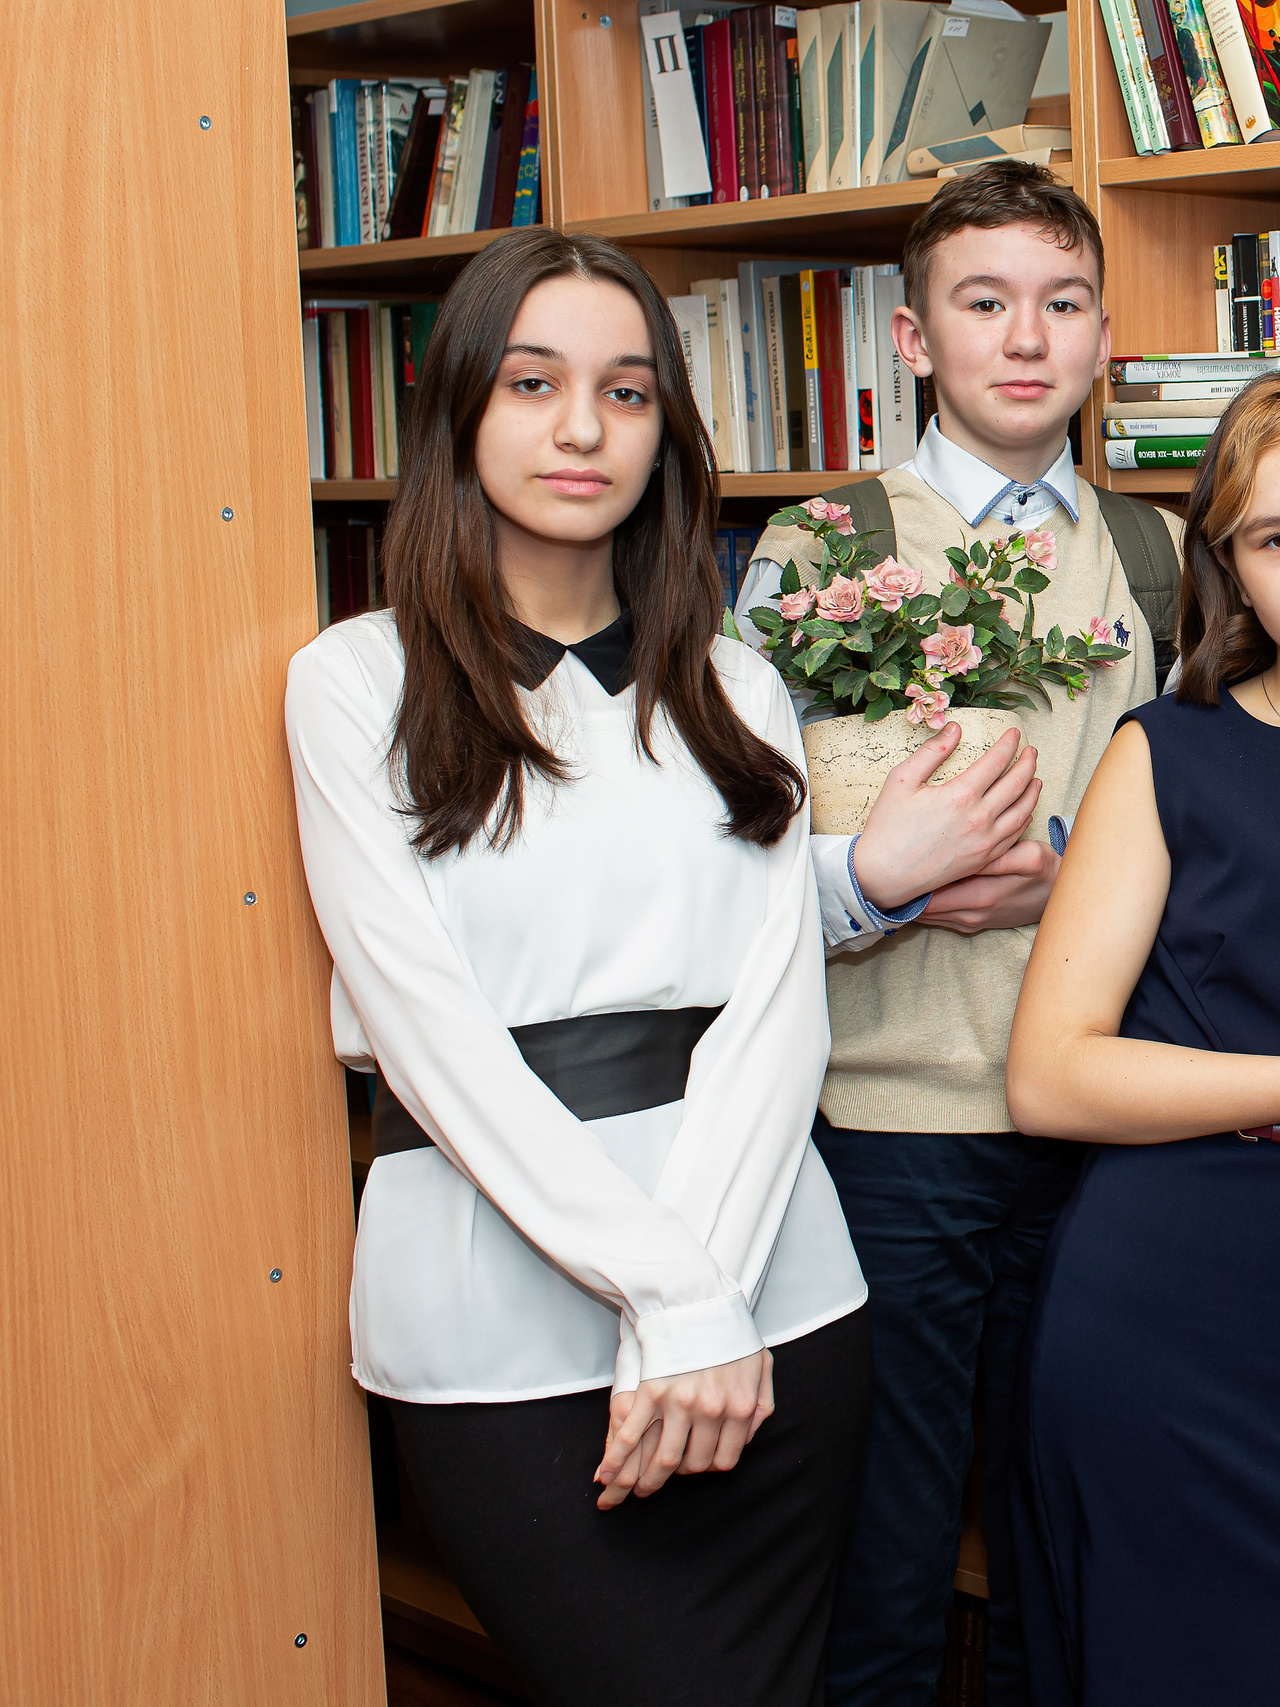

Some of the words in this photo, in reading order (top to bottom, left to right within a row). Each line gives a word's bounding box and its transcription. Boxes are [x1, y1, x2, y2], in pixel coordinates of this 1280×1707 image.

[653, 33, 683, 74] П
[359, 132, 369, 206] КУПРИН
[767, 290, 776, 333] РАССКАЗЫ
[803, 323, 814, 360] Собака
[1156, 362, 1182, 371] УХОДИТ
[1196, 365, 1230, 373] БРУШТЕЙН
[1230, 363, 1269, 372] АЛЕКСАНДРА
[1156, 370, 1182, 378] ДОРОГА
[894, 411, 902, 421] В.
[1137, 450, 1156, 458] ВЕКОВ
